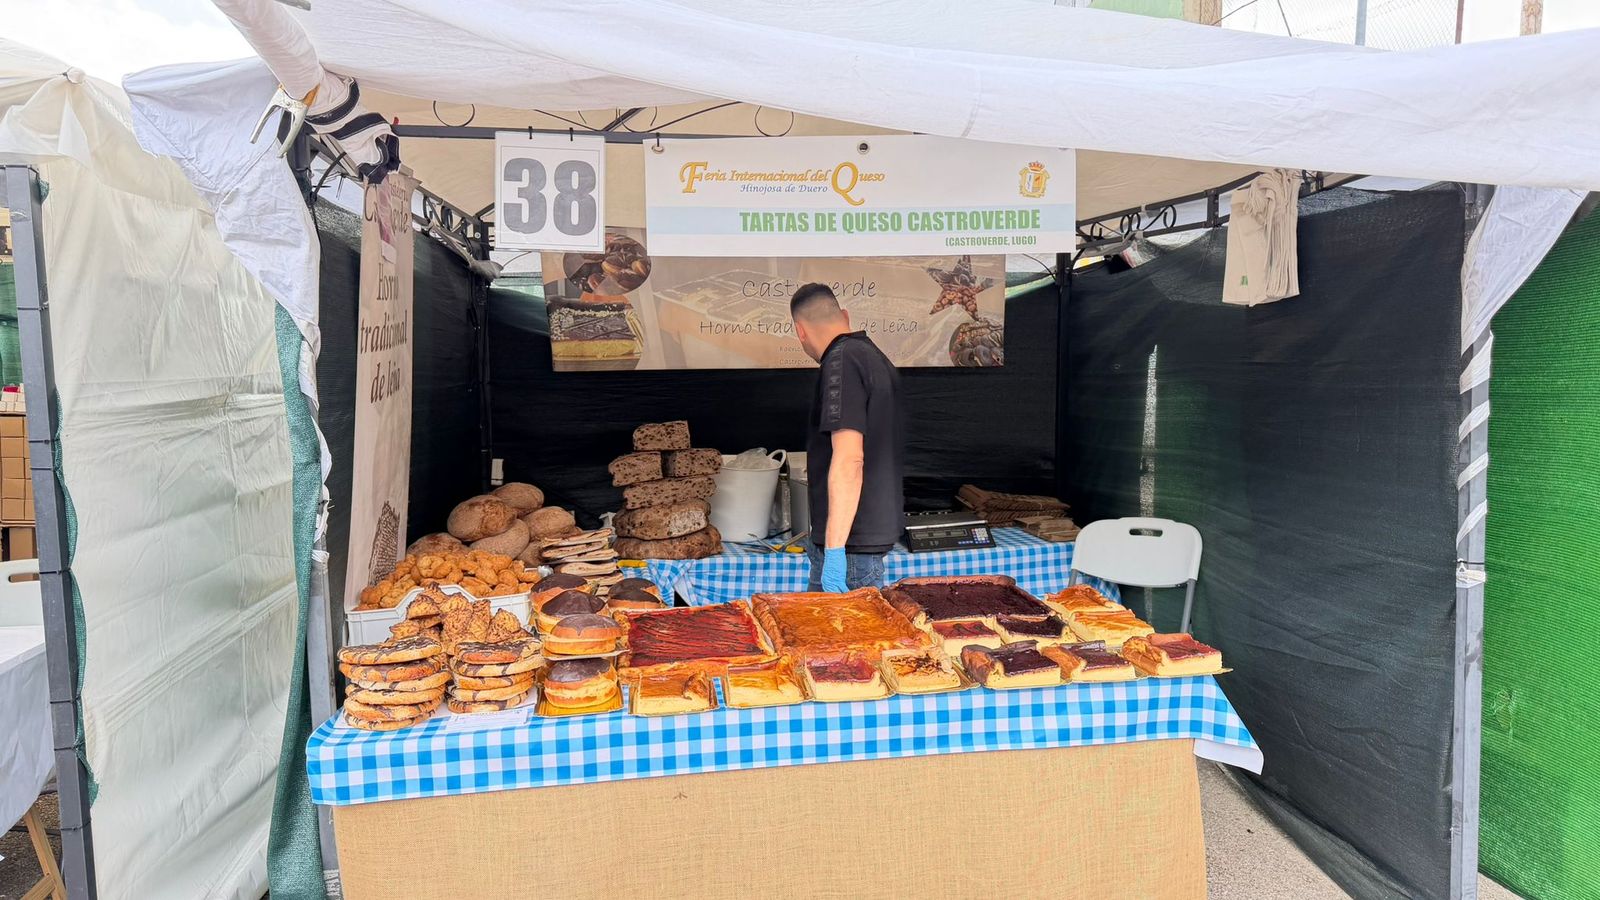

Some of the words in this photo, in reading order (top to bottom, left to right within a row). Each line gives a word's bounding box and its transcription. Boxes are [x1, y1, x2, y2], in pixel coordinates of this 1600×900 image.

[679, 161, 726, 194] Feria
[728, 169, 808, 182] Internacional
[809, 169, 831, 182] del
[831, 161, 886, 206] Queso
[740, 184, 782, 195] Hinojosa
[784, 184, 796, 193] de
[798, 185, 828, 193] Duero
[503, 157, 597, 236] 38
[739, 211, 809, 233] TARTAS
[814, 211, 837, 232] DE
[842, 211, 903, 234] QUESO
[907, 209, 1041, 232] CASTROVERDE
[1011, 235, 1037, 246] LUGO)
[700, 320, 752, 335] Horno
[859, 318, 877, 333] de
[882, 318, 919, 333] leña
[371, 362, 385, 403] de
